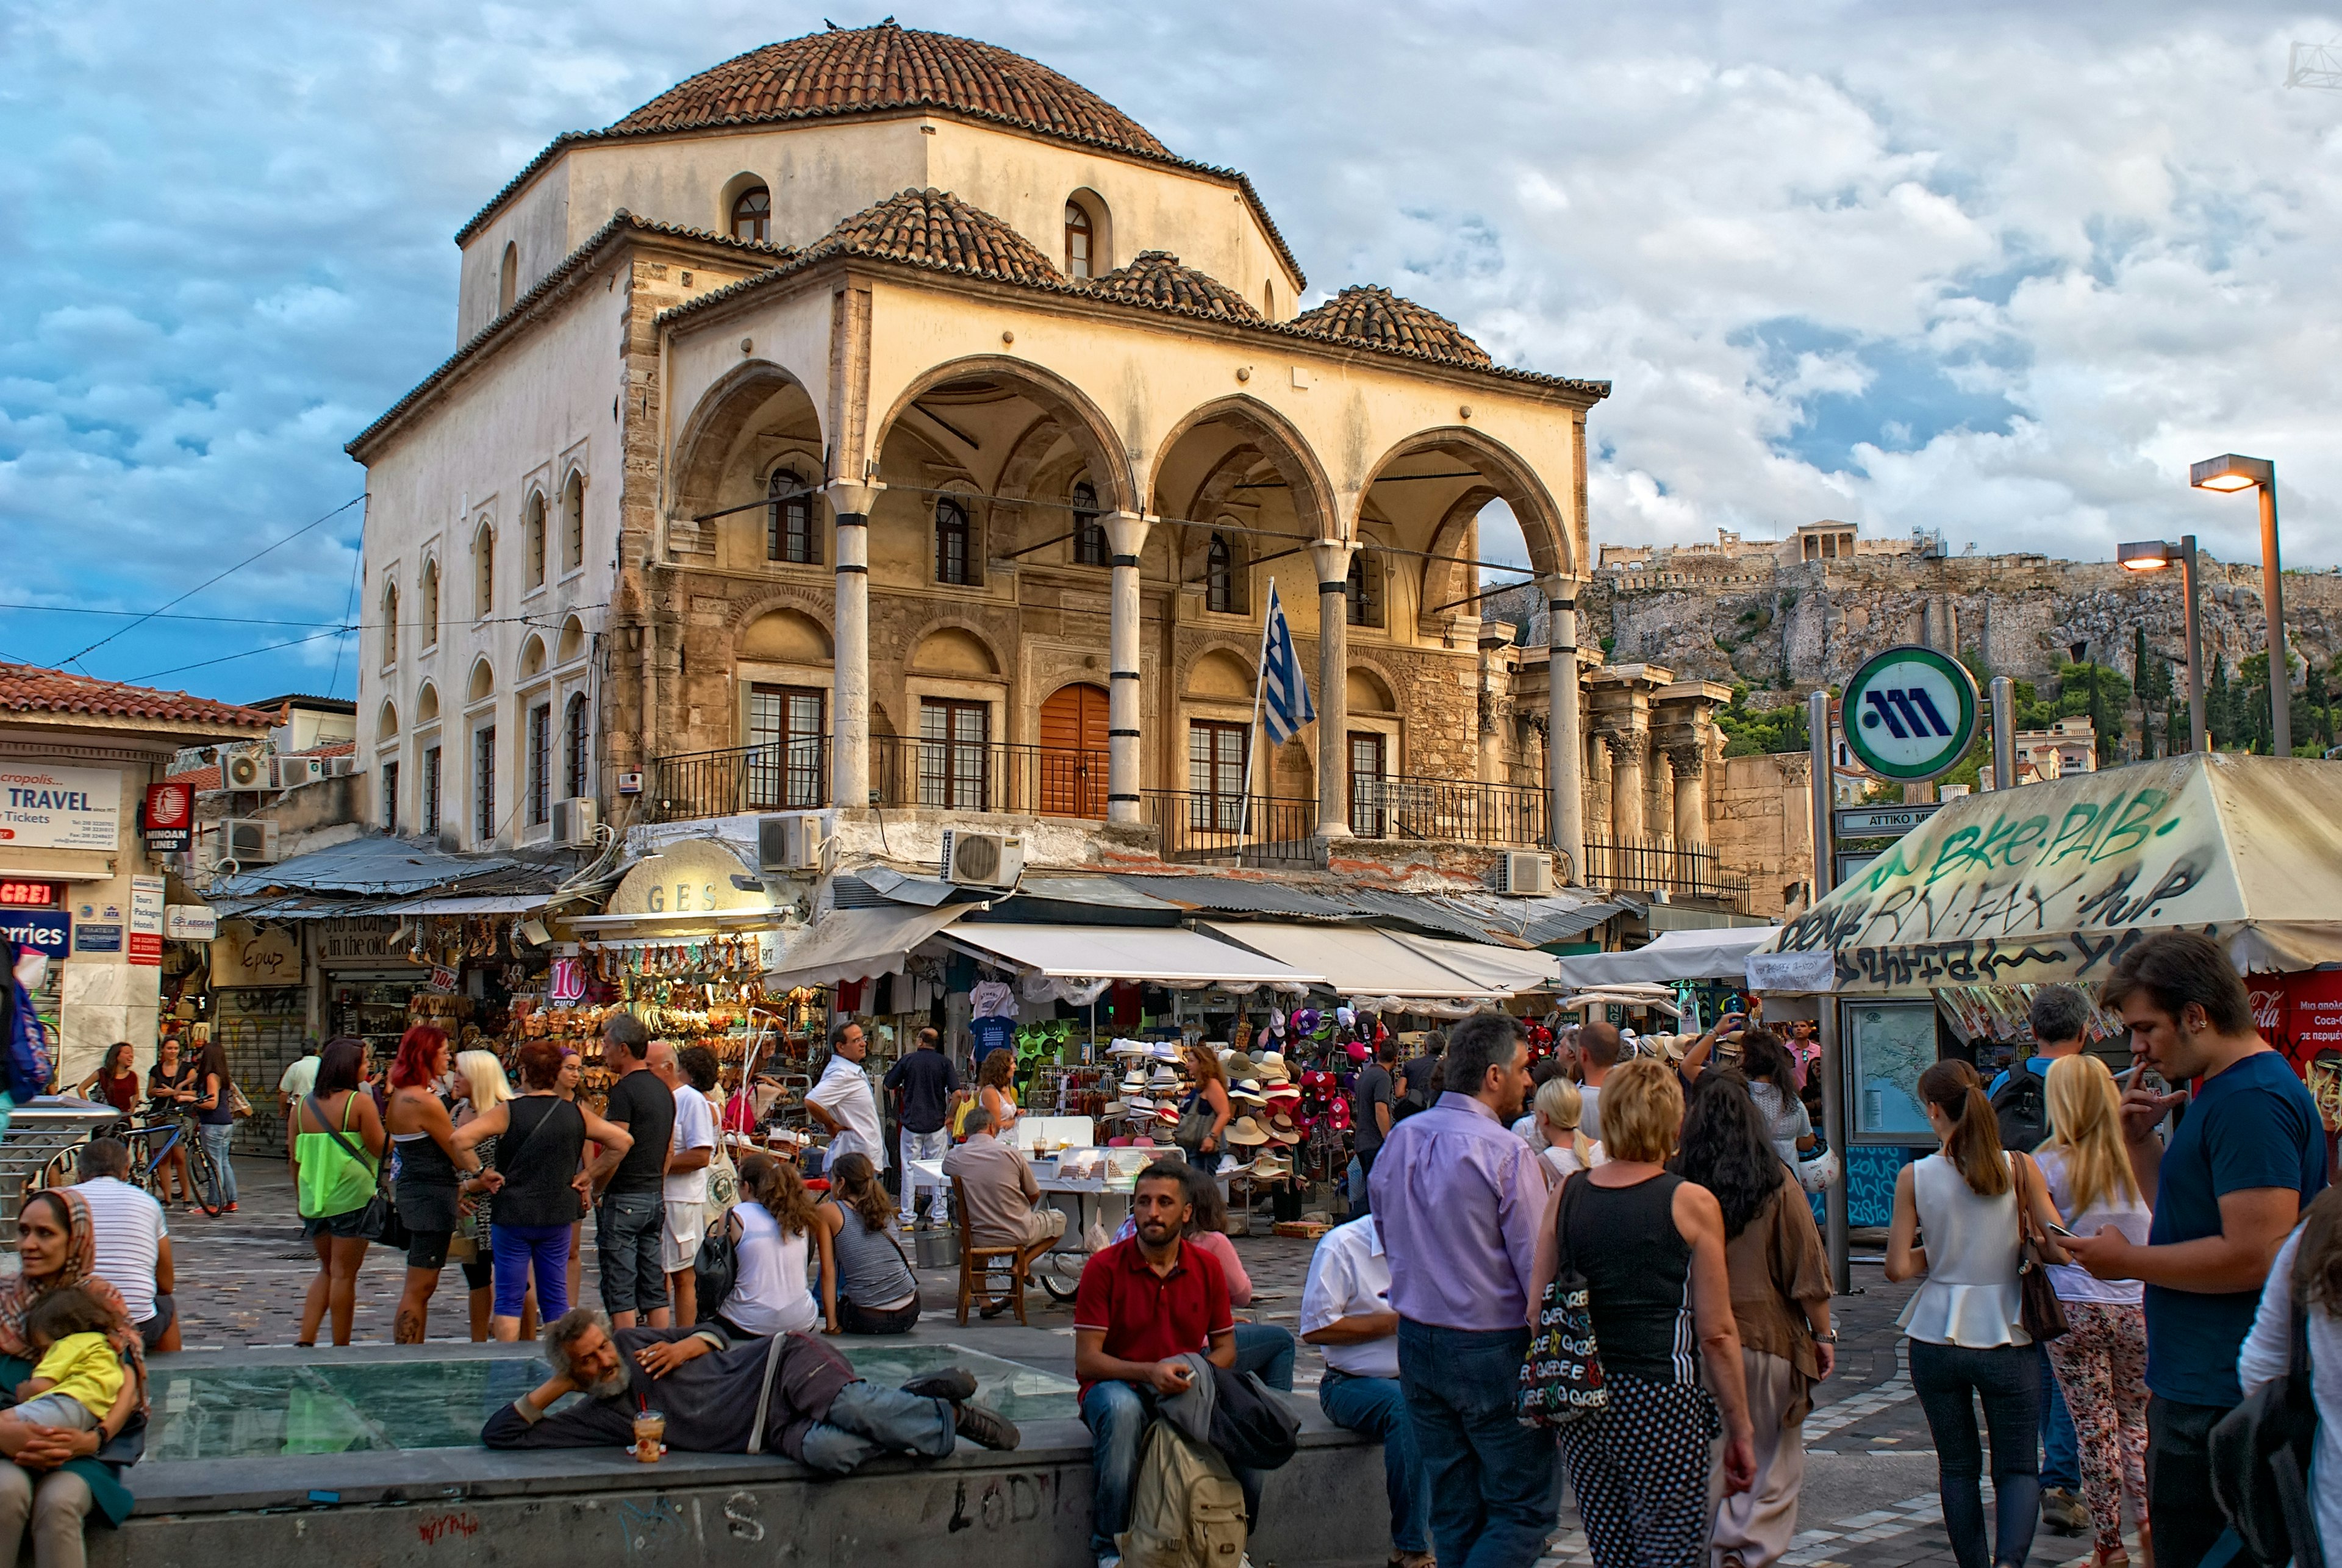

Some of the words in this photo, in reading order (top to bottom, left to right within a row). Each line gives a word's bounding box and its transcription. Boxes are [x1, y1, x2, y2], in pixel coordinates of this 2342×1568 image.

[9, 787, 92, 811] TRAVEL
[5, 811, 50, 824] Tickets
[146, 830, 188, 840] MINOAN
[151, 840, 179, 850] LINES
[135, 895, 152, 904] Tours
[134, 908, 162, 919] Packages
[134, 920, 155, 929] Hotels
[329, 936, 341, 956] in
[344, 935, 365, 956] the
[367, 936, 387, 956] old
[762, 948, 774, 961] 97
[432, 970, 454, 989] 10€
[552, 958, 587, 1001] 10
[554, 999, 576, 1008] euro
[2300, 1001, 2316, 1010] Μια
